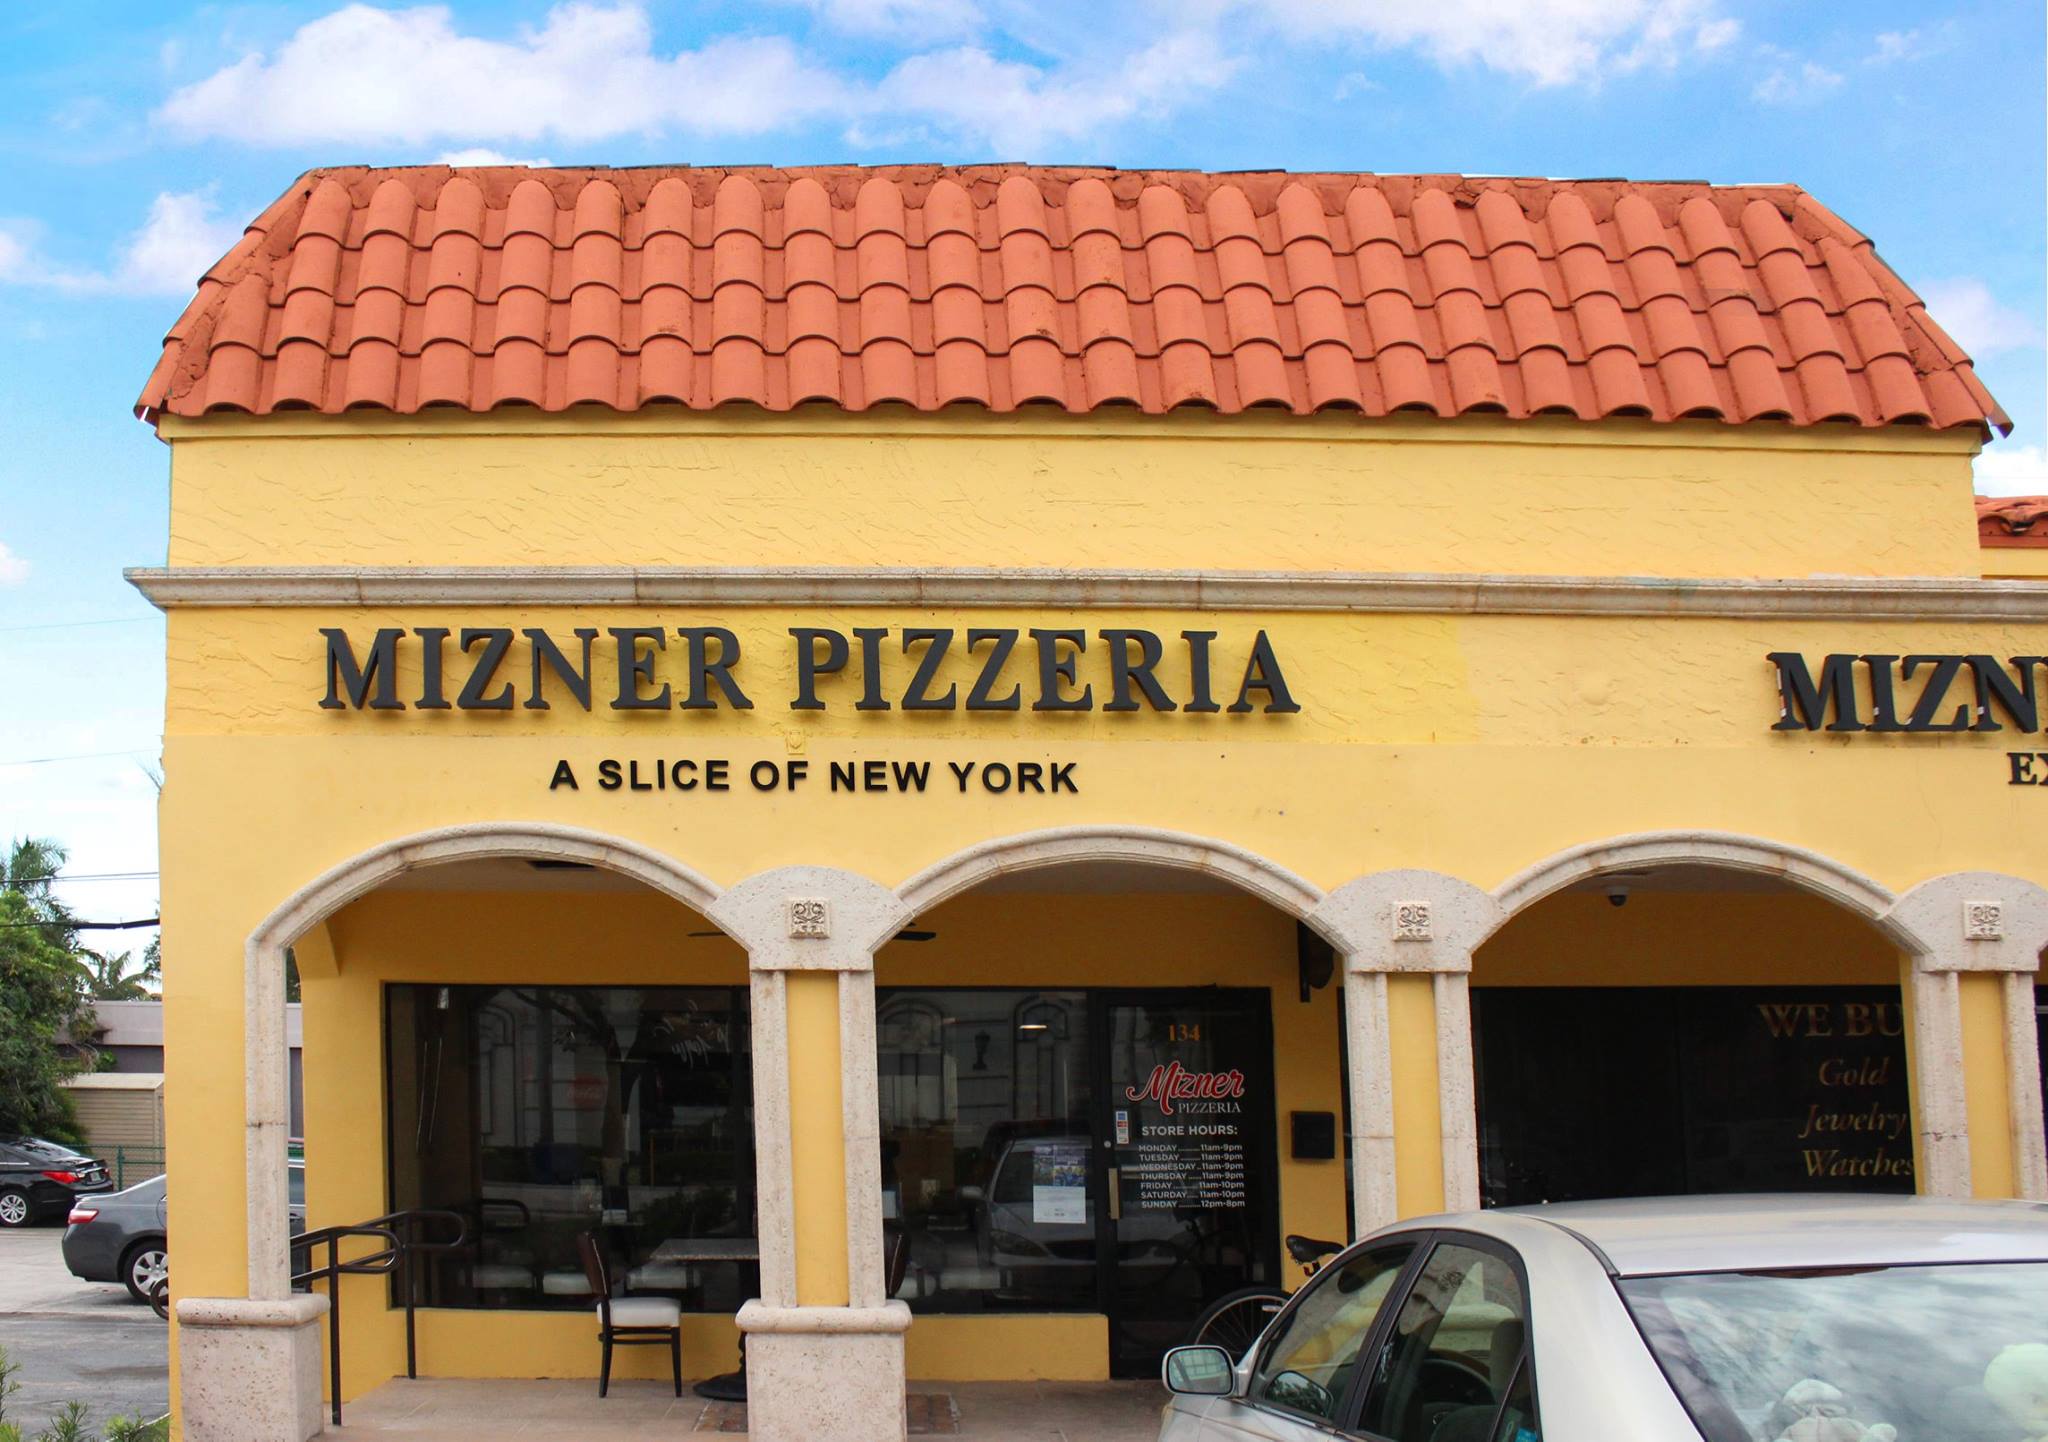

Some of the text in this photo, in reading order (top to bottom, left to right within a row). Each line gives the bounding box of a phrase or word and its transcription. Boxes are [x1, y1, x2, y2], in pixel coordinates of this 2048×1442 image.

[318, 627, 1301, 714] MIZNER PIZZERIA
[1766, 652, 2048, 734] MIZN
[549, 759, 1079, 793] A SLICE OF NEW YORK
[1758, 1003, 1833, 1038] WE
[1168, 1024, 1201, 1041] 134
[1818, 1057, 1889, 1086] Gold
[1126, 1060, 1245, 1116] Mizner
[1178, 1102, 1242, 1114] PIZZERIA
[1797, 1102, 1908, 1140] Jewelry
[1142, 1125, 1239, 1136] STORE HOURS:
[1138, 1144, 1178, 1152] MONDAY
[1139, 1153, 1180, 1161] TUESDAY
[1802, 1149, 1914, 1177] Watches
[1139, 1163, 1196, 1171] WEDNESDAY
[1140, 1172, 1187, 1180] THURSDAY
[1140, 1182, 1173, 1190] FRIDAY
[1140, 1191, 1187, 1199] SATURDAY
[1141, 1200, 1178, 1209] SUNDAY
